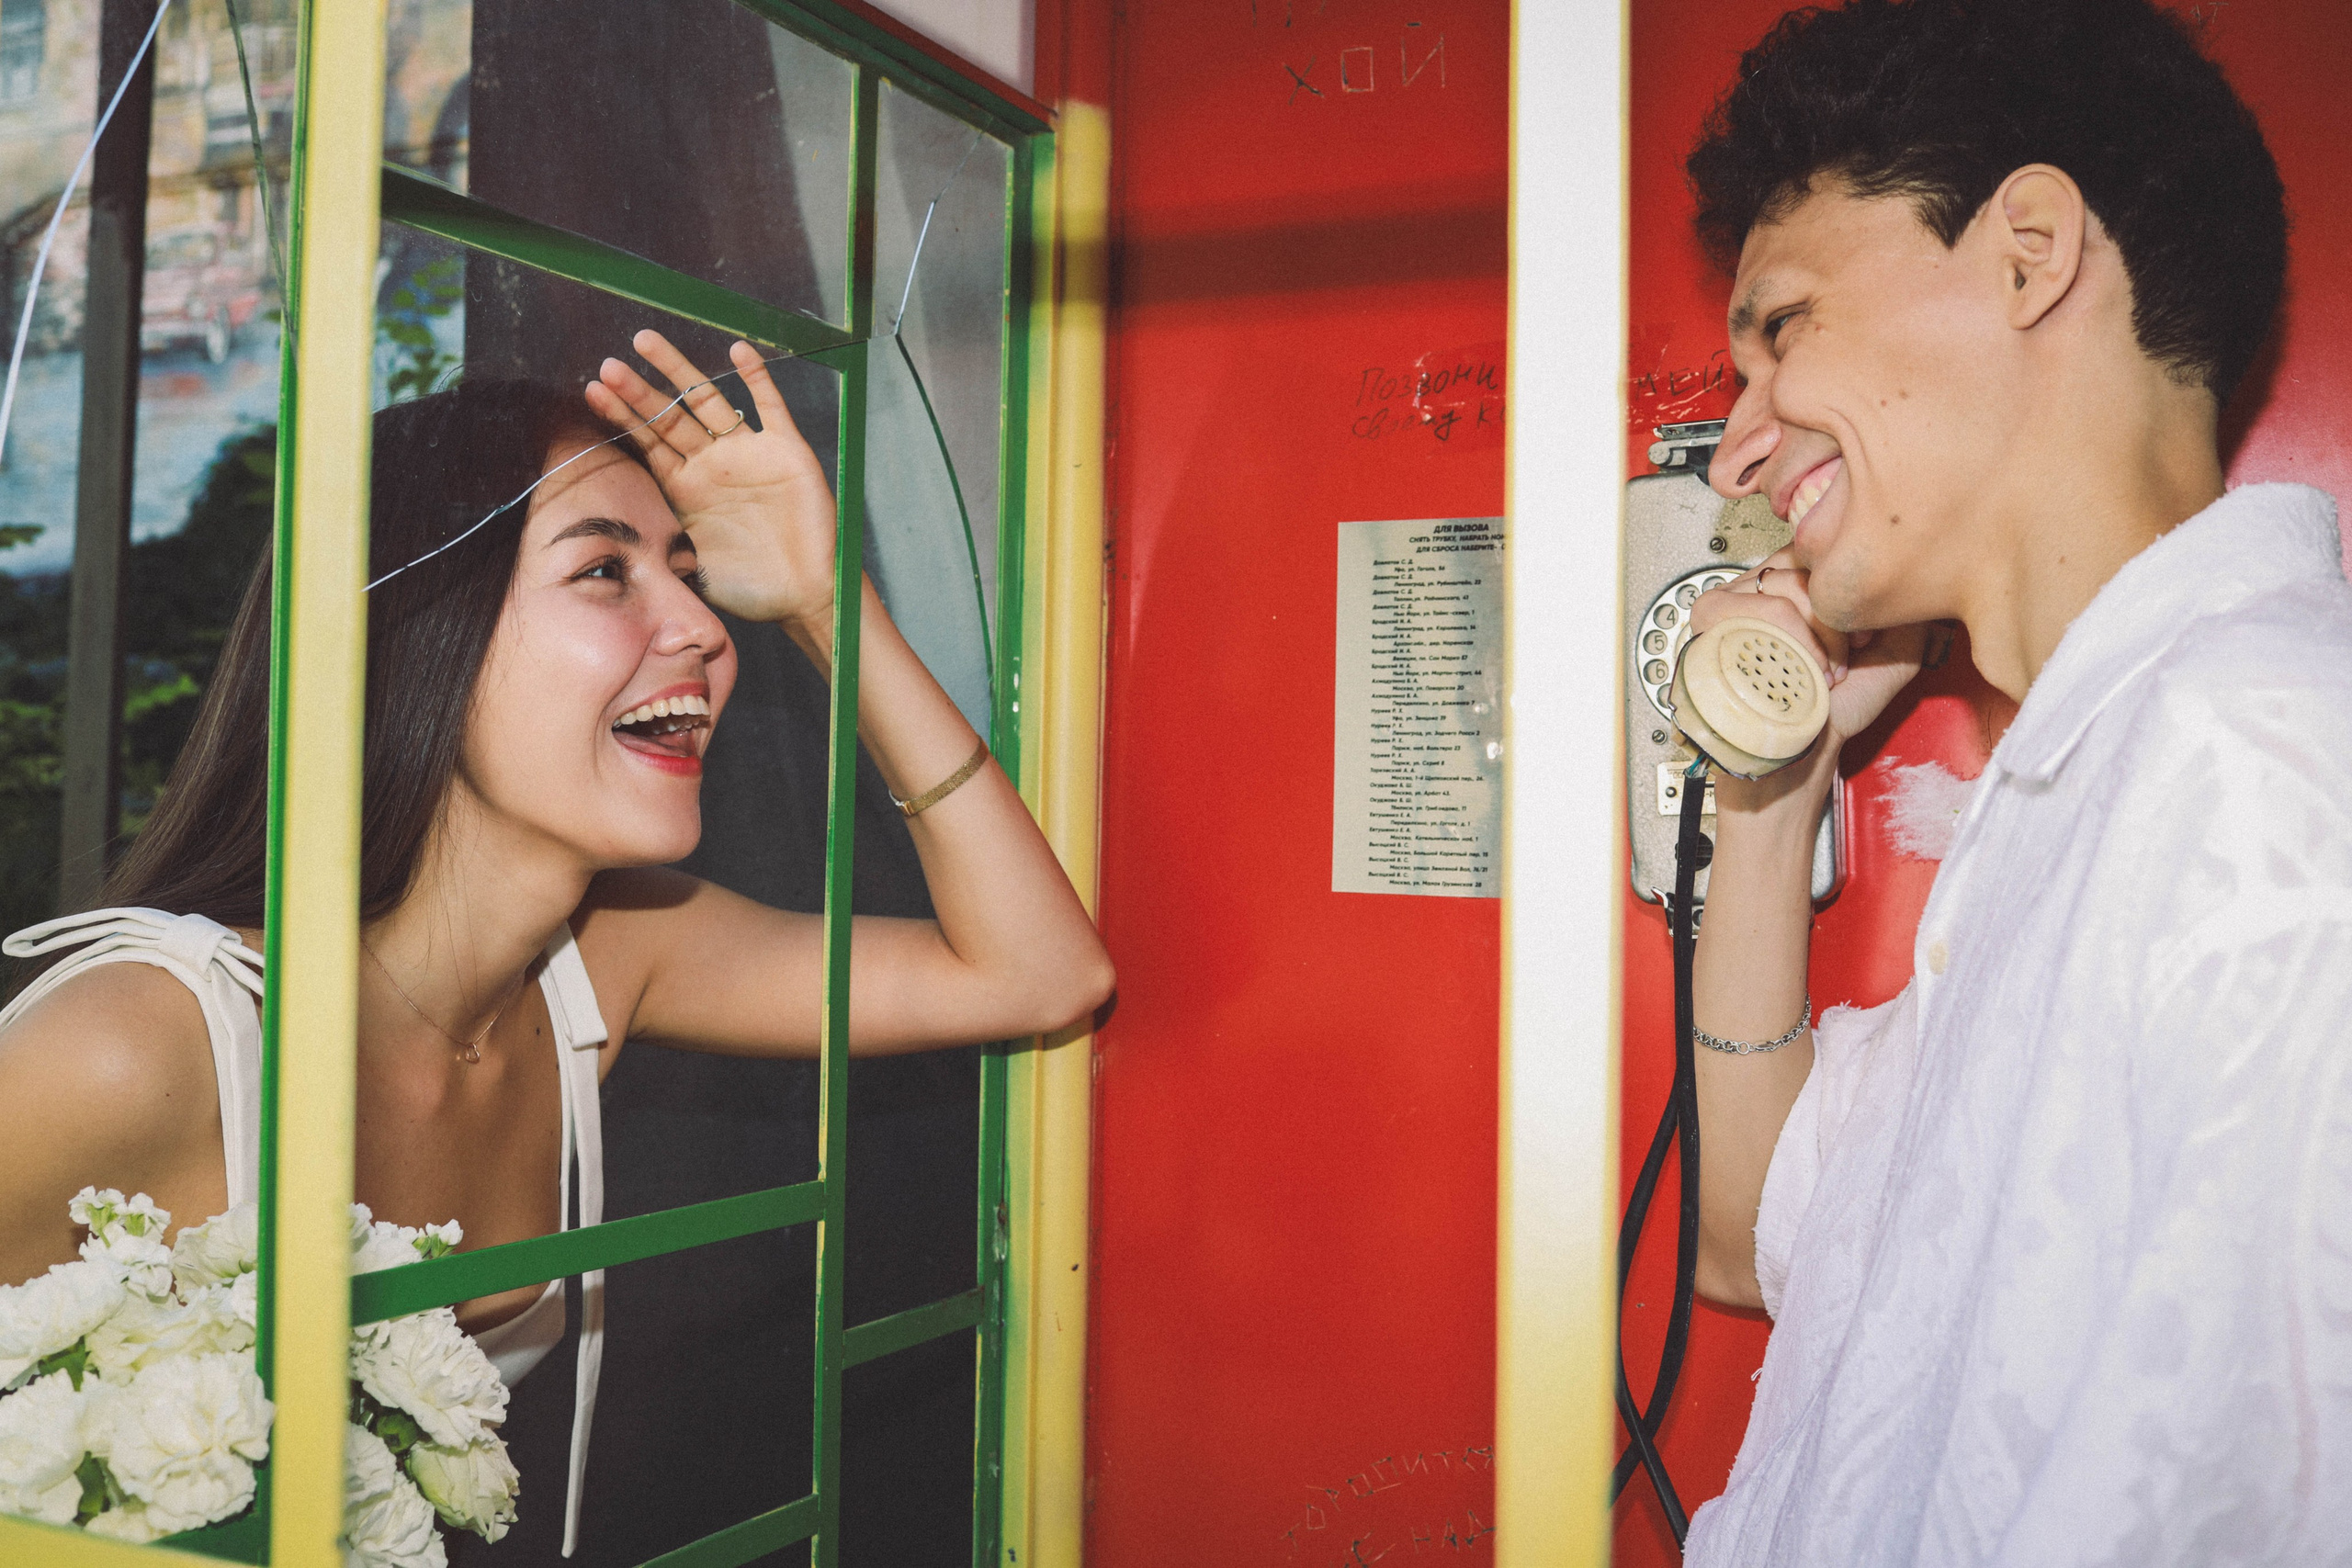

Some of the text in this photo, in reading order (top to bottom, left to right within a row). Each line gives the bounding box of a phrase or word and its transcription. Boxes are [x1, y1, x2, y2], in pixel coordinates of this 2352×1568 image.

[1433, 524, 1489, 534] ДЛЯ ВЫЗОВА
[1687, 590, 1697, 606] 3
[1667, 609, 1676, 625] 4
[1654, 635, 1665, 651] 5
[1656, 662, 1666, 679] 6
